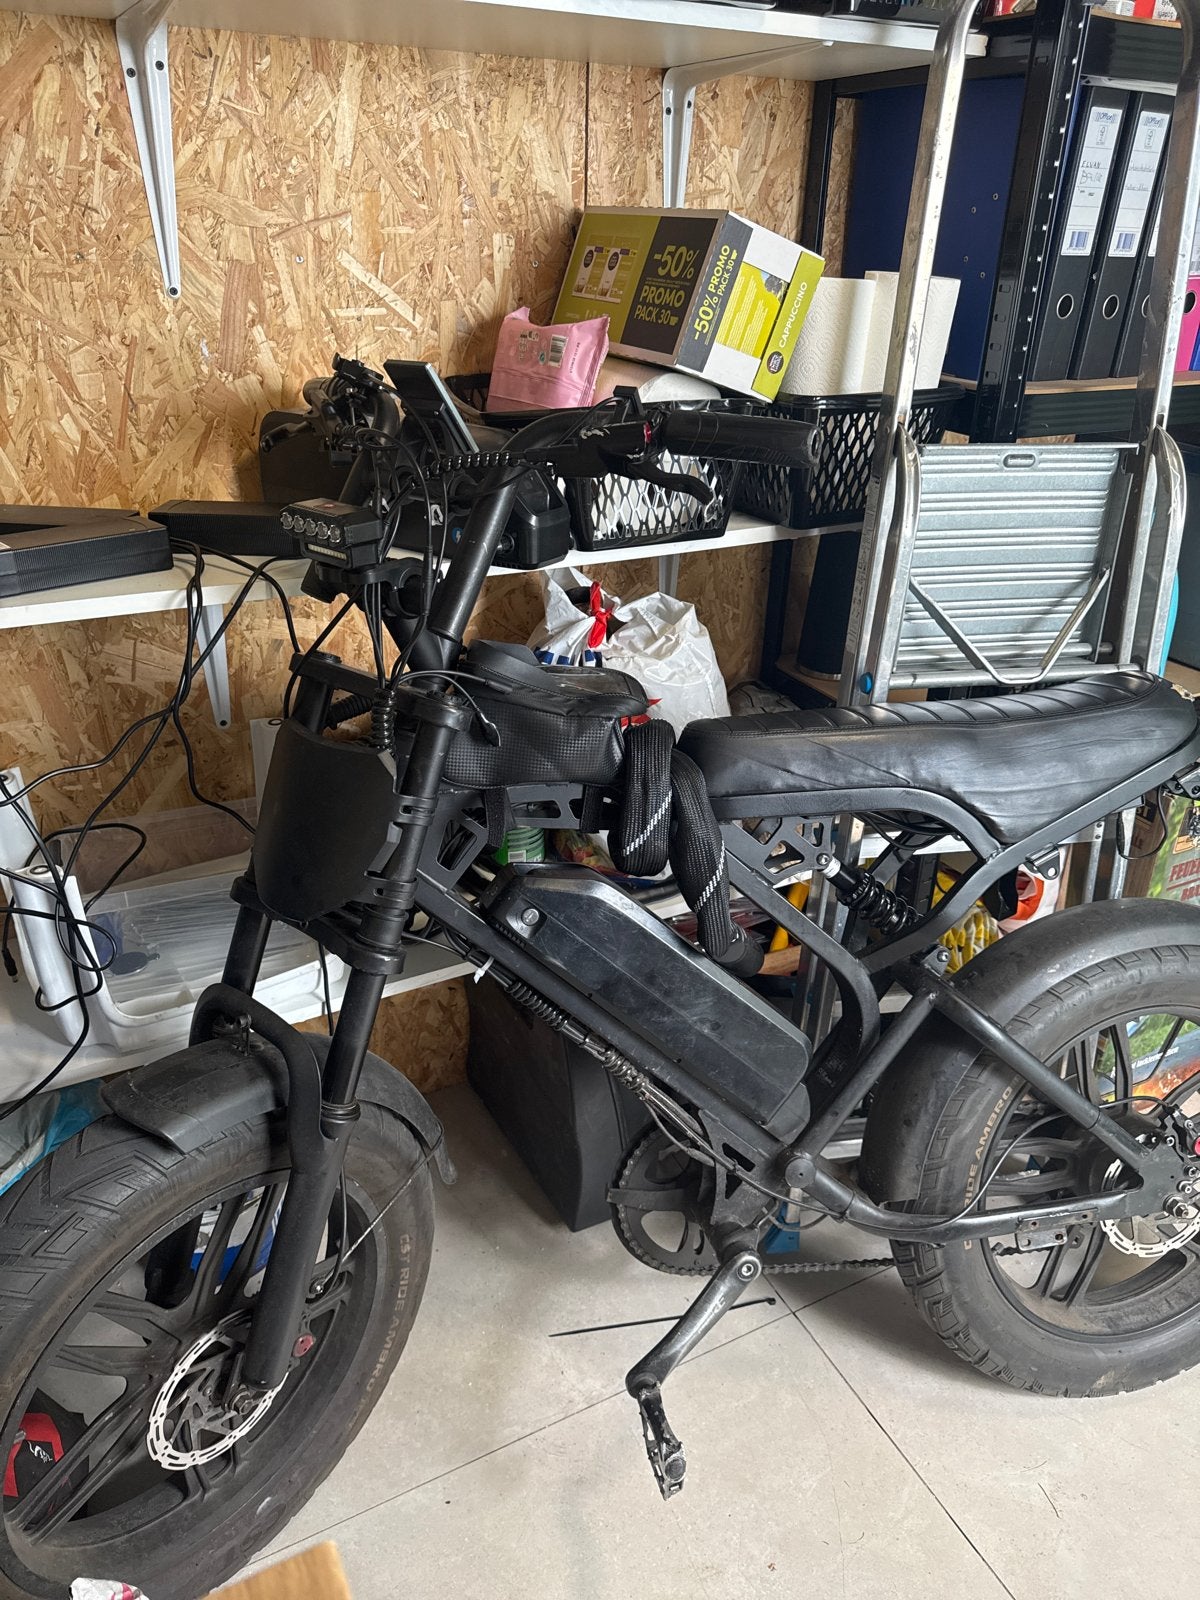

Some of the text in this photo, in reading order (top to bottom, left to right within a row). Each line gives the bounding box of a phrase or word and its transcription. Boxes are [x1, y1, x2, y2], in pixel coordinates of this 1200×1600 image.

[652, 245, 700, 280] -50%
[717, 260, 735, 296] PACK 30
[640, 284, 685, 308] PROMO
[694, 294, 719, 341] -50%
[708, 245, 731, 293] PROMO
[633, 304, 671, 325] PACK 30
[778, 281, 808, 349] CAPPUCCINO
[395, 1267, 410, 1311] RIDE
[366, 1315, 400, 1393] AMBRO
